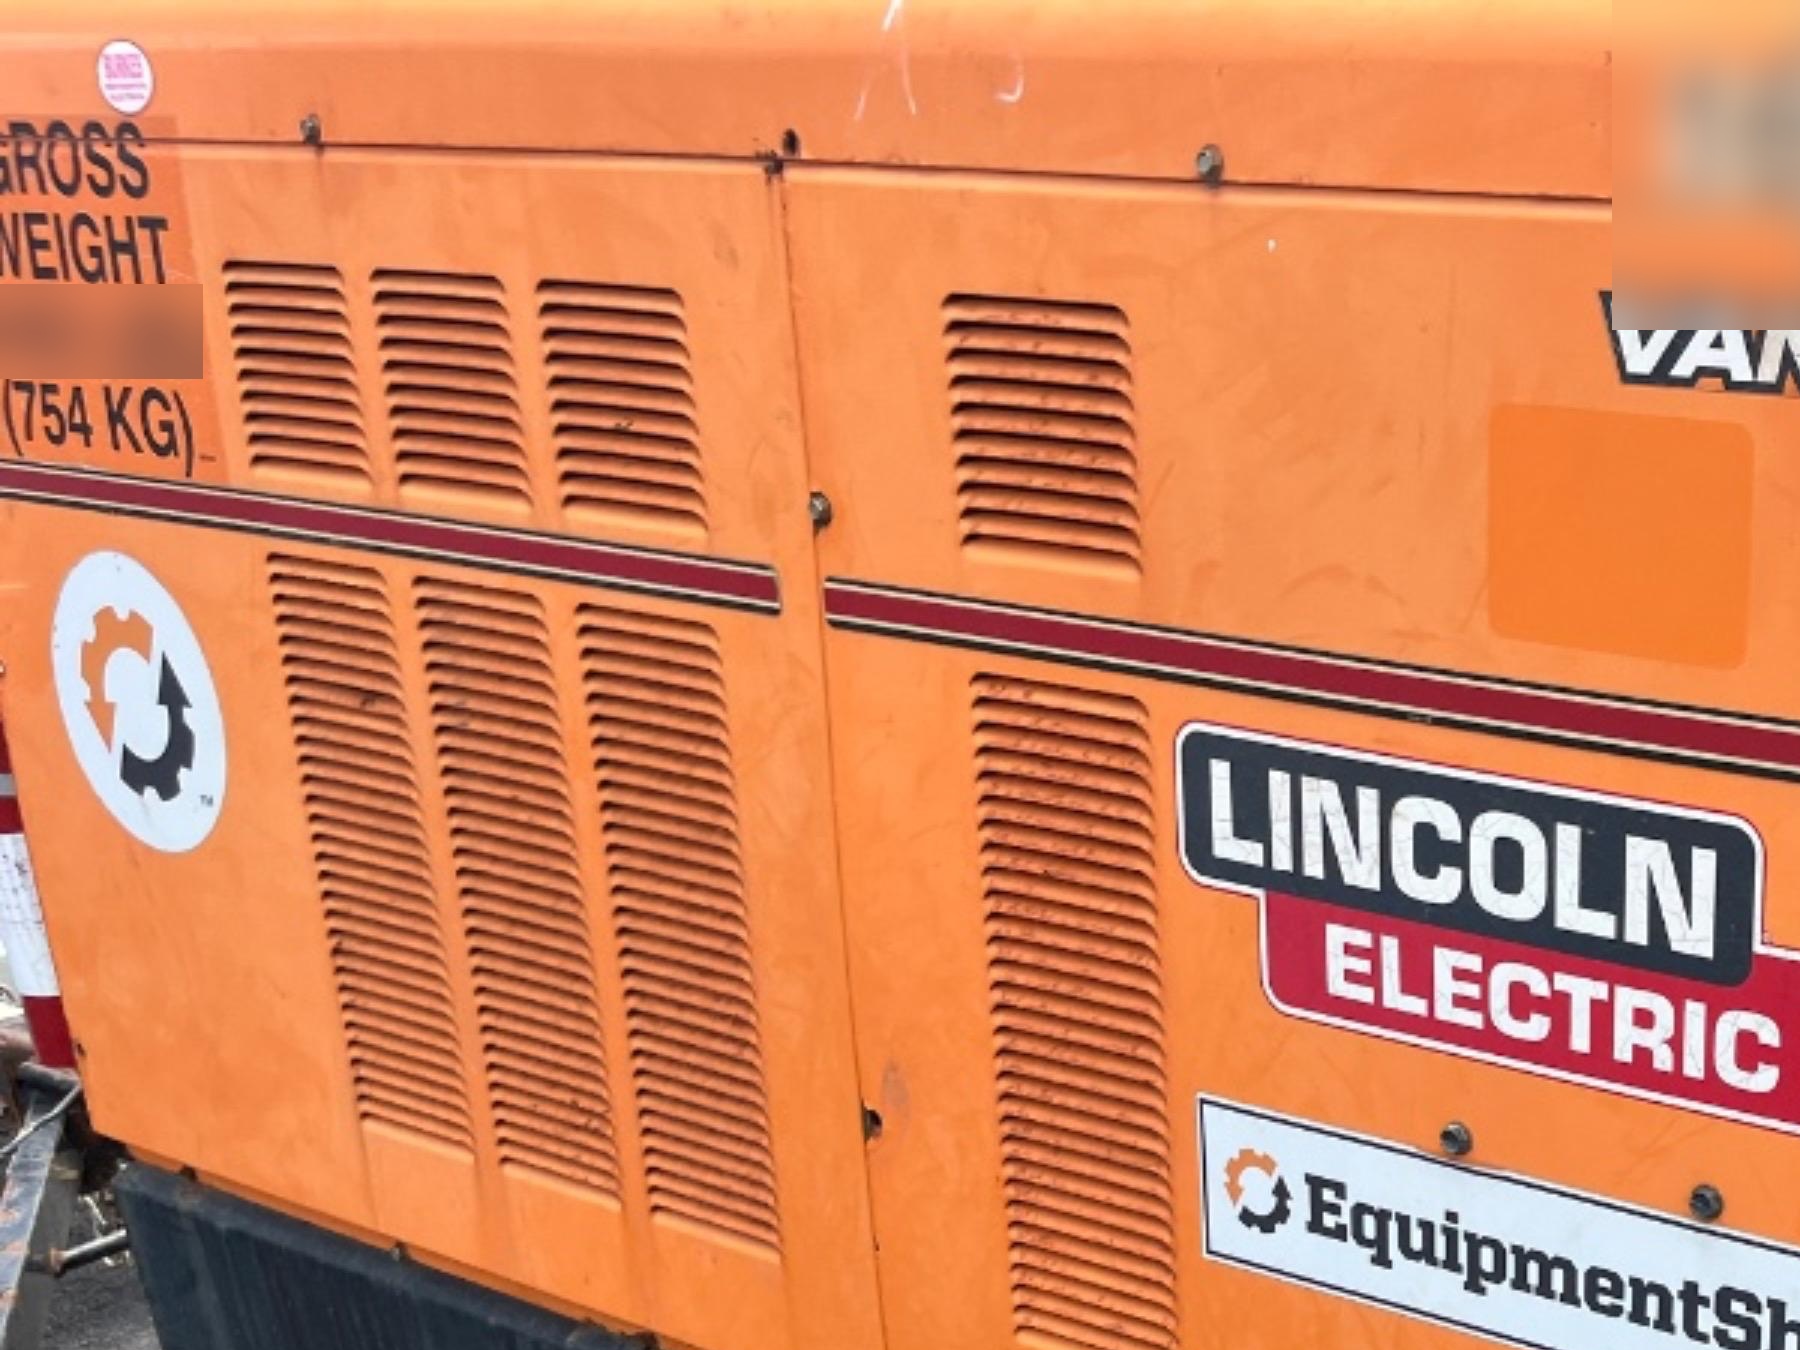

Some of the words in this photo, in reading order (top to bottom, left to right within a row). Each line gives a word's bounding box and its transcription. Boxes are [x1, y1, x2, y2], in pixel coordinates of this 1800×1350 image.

[4, 379, 93, 456] (754
[103, 386, 194, 477] KG)
[1208, 757, 1717, 960] LINCOLN
[1324, 922, 1782, 1093] ELECTRIC
